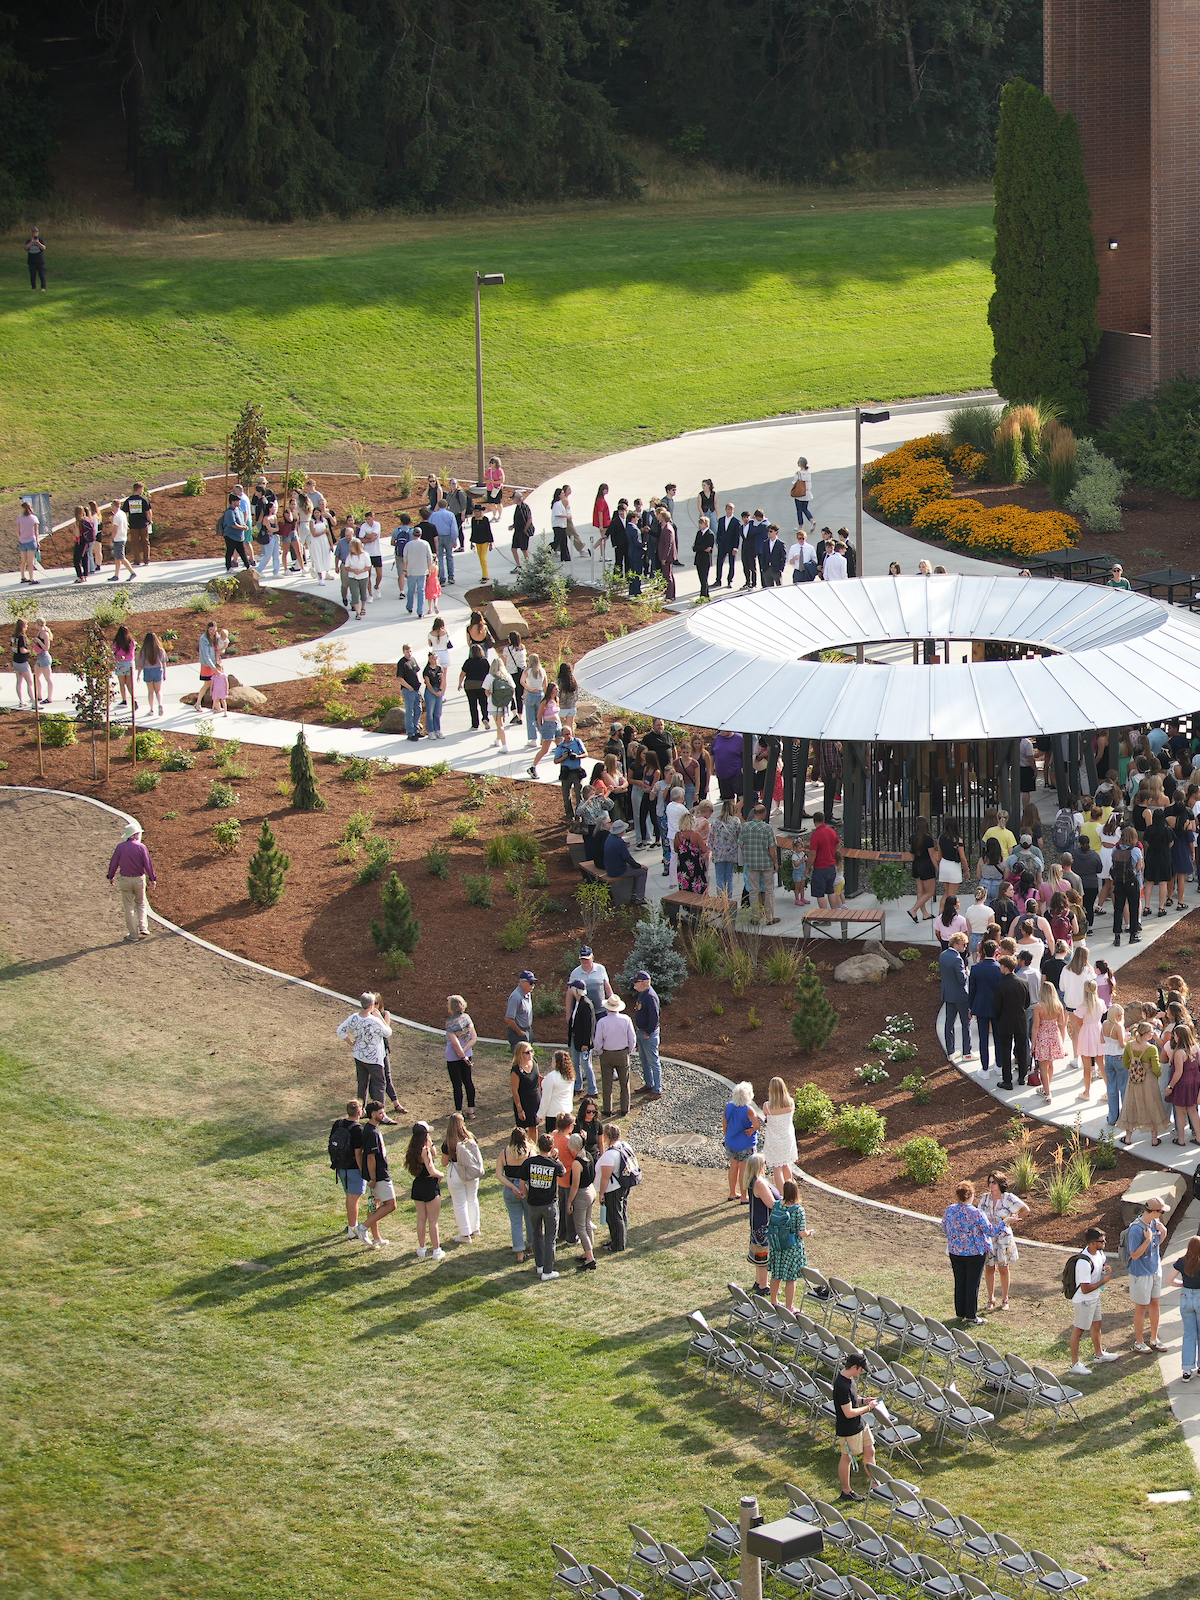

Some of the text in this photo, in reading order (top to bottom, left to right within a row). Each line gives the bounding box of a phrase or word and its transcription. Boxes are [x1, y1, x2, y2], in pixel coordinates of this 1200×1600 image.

[530, 1166, 554, 1176] MAKE
[530, 1173, 553, 1181] DESIGN
[530, 1179, 552, 1187] CREATE
